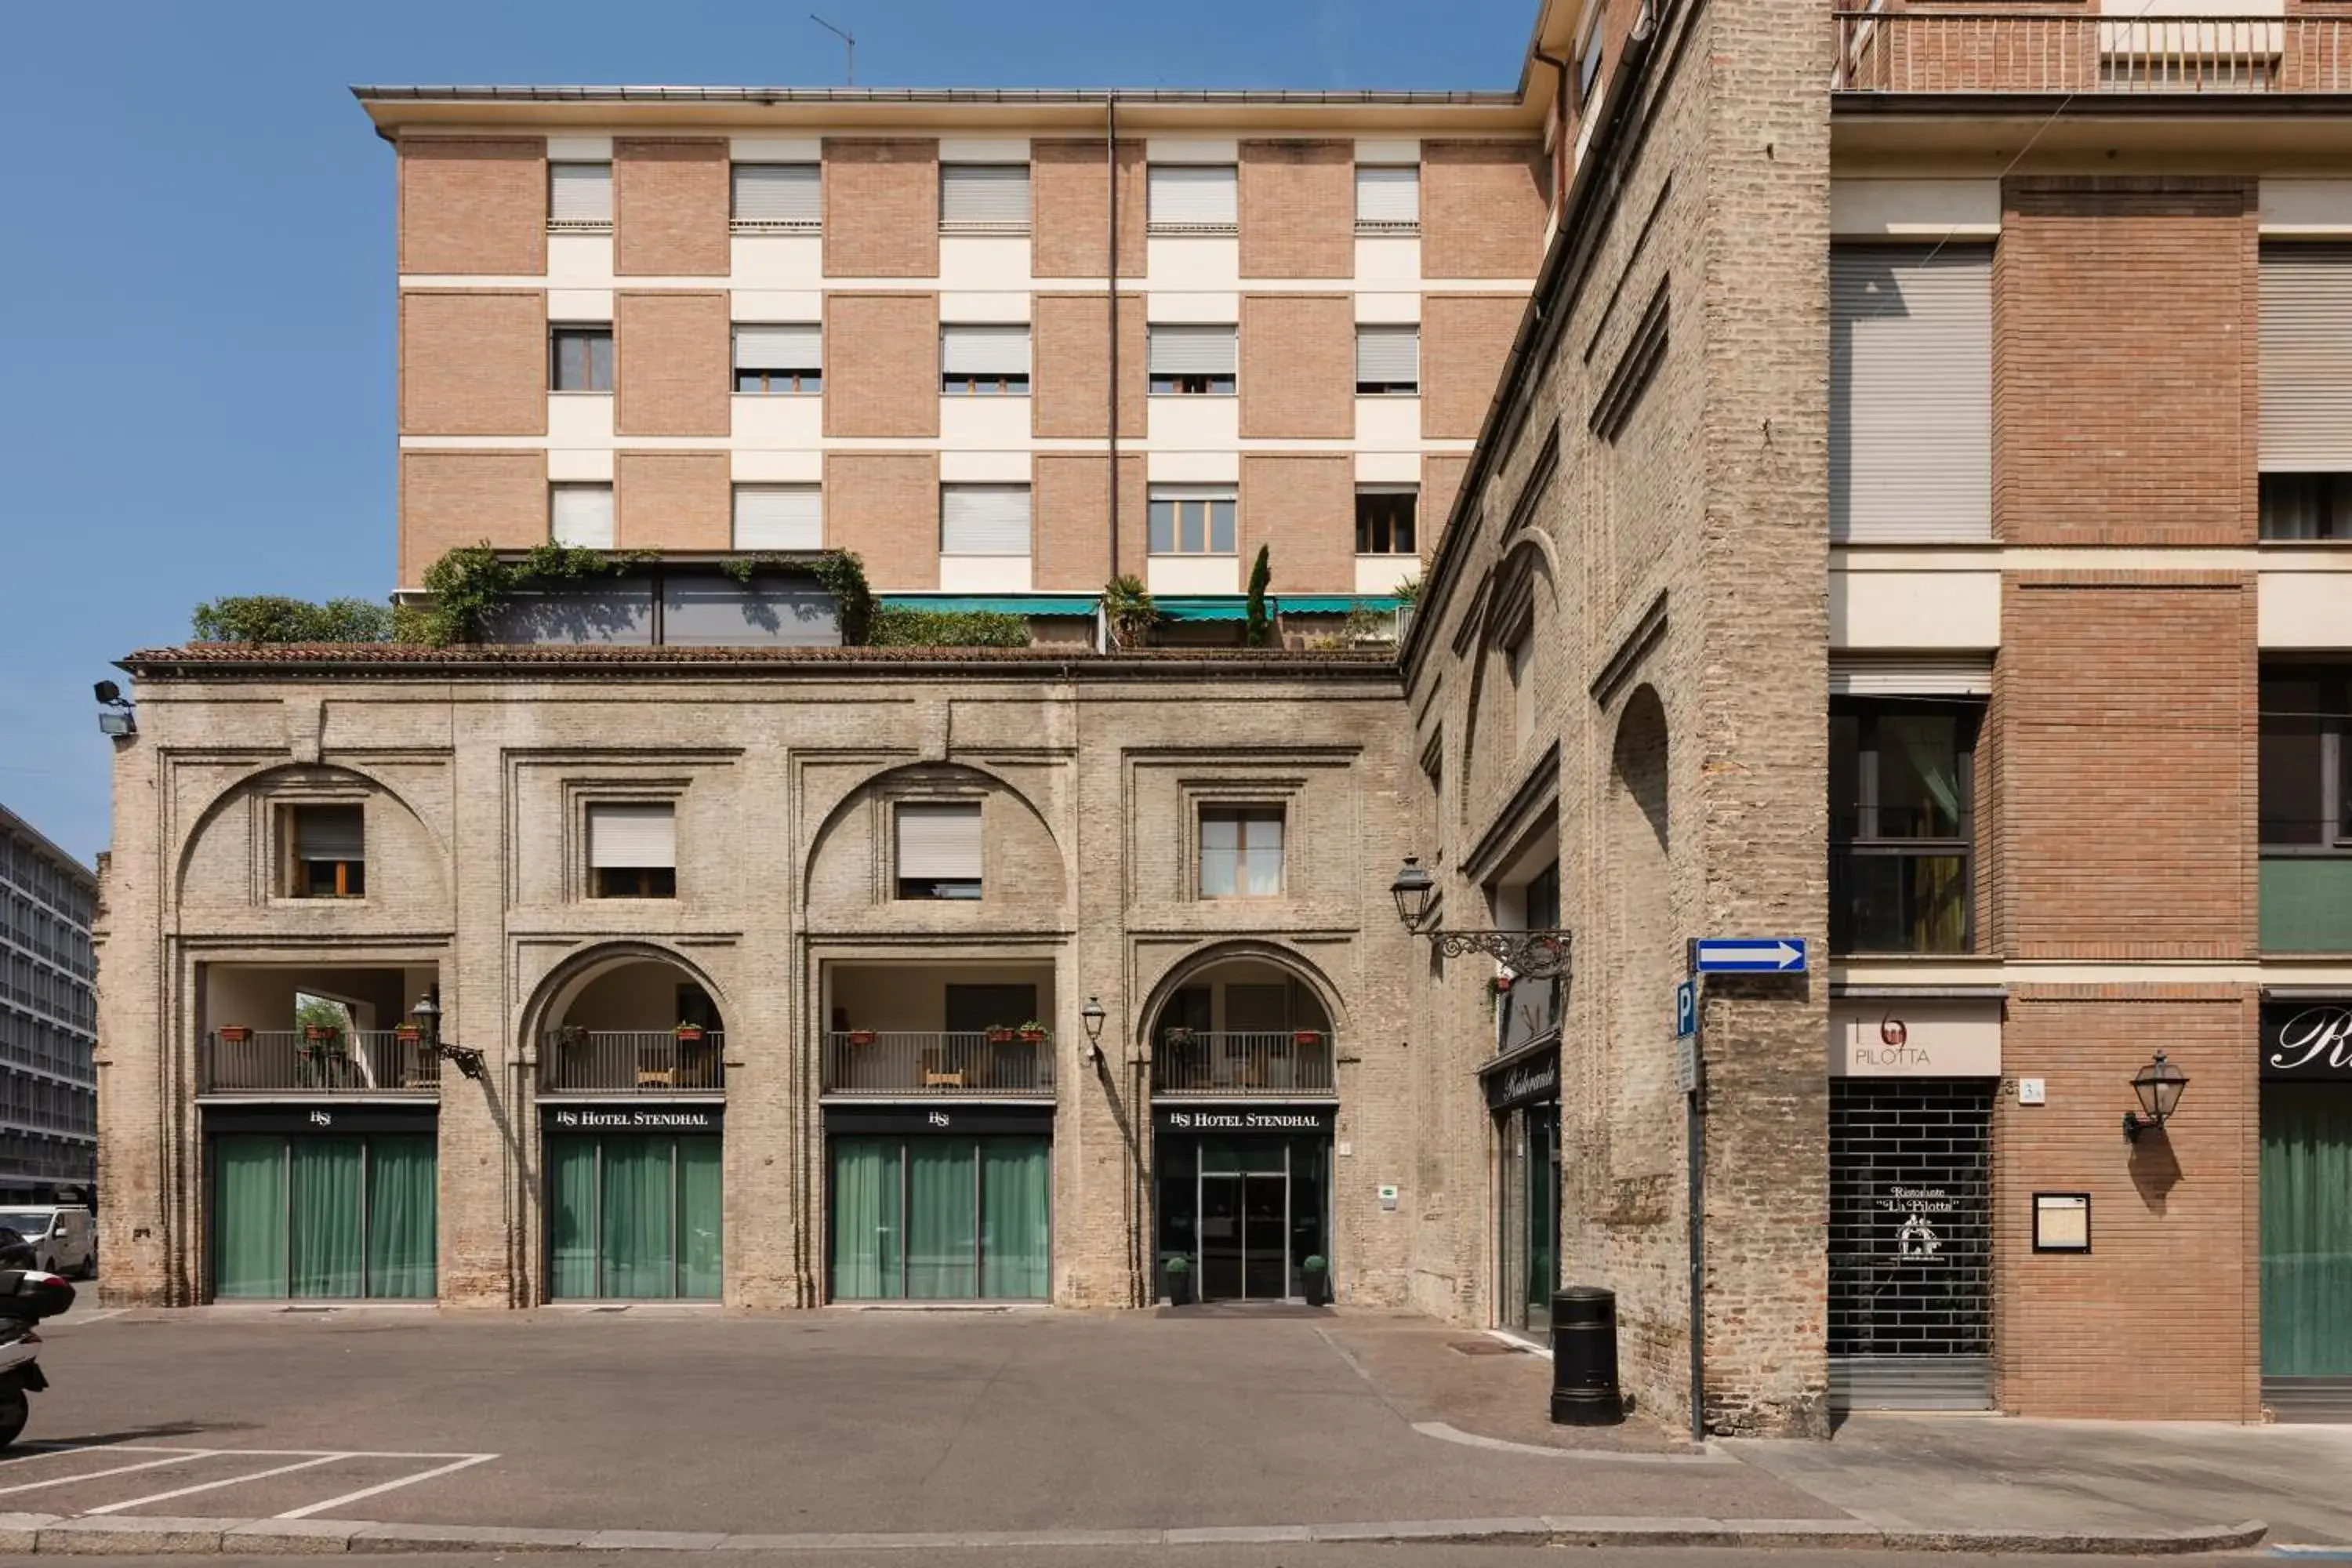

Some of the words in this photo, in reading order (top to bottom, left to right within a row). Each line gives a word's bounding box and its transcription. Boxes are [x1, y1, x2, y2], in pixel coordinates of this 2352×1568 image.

[1680, 987, 1691, 1033] P
[1855, 1048, 1931, 1065] PILOTTA
[582, 1111, 630, 1125] HOTEL
[634, 1111, 708, 1125] STENDHAL
[1195, 1112, 1243, 1127] HOTEL
[1246, 1112, 1319, 1127] STENDHAL
